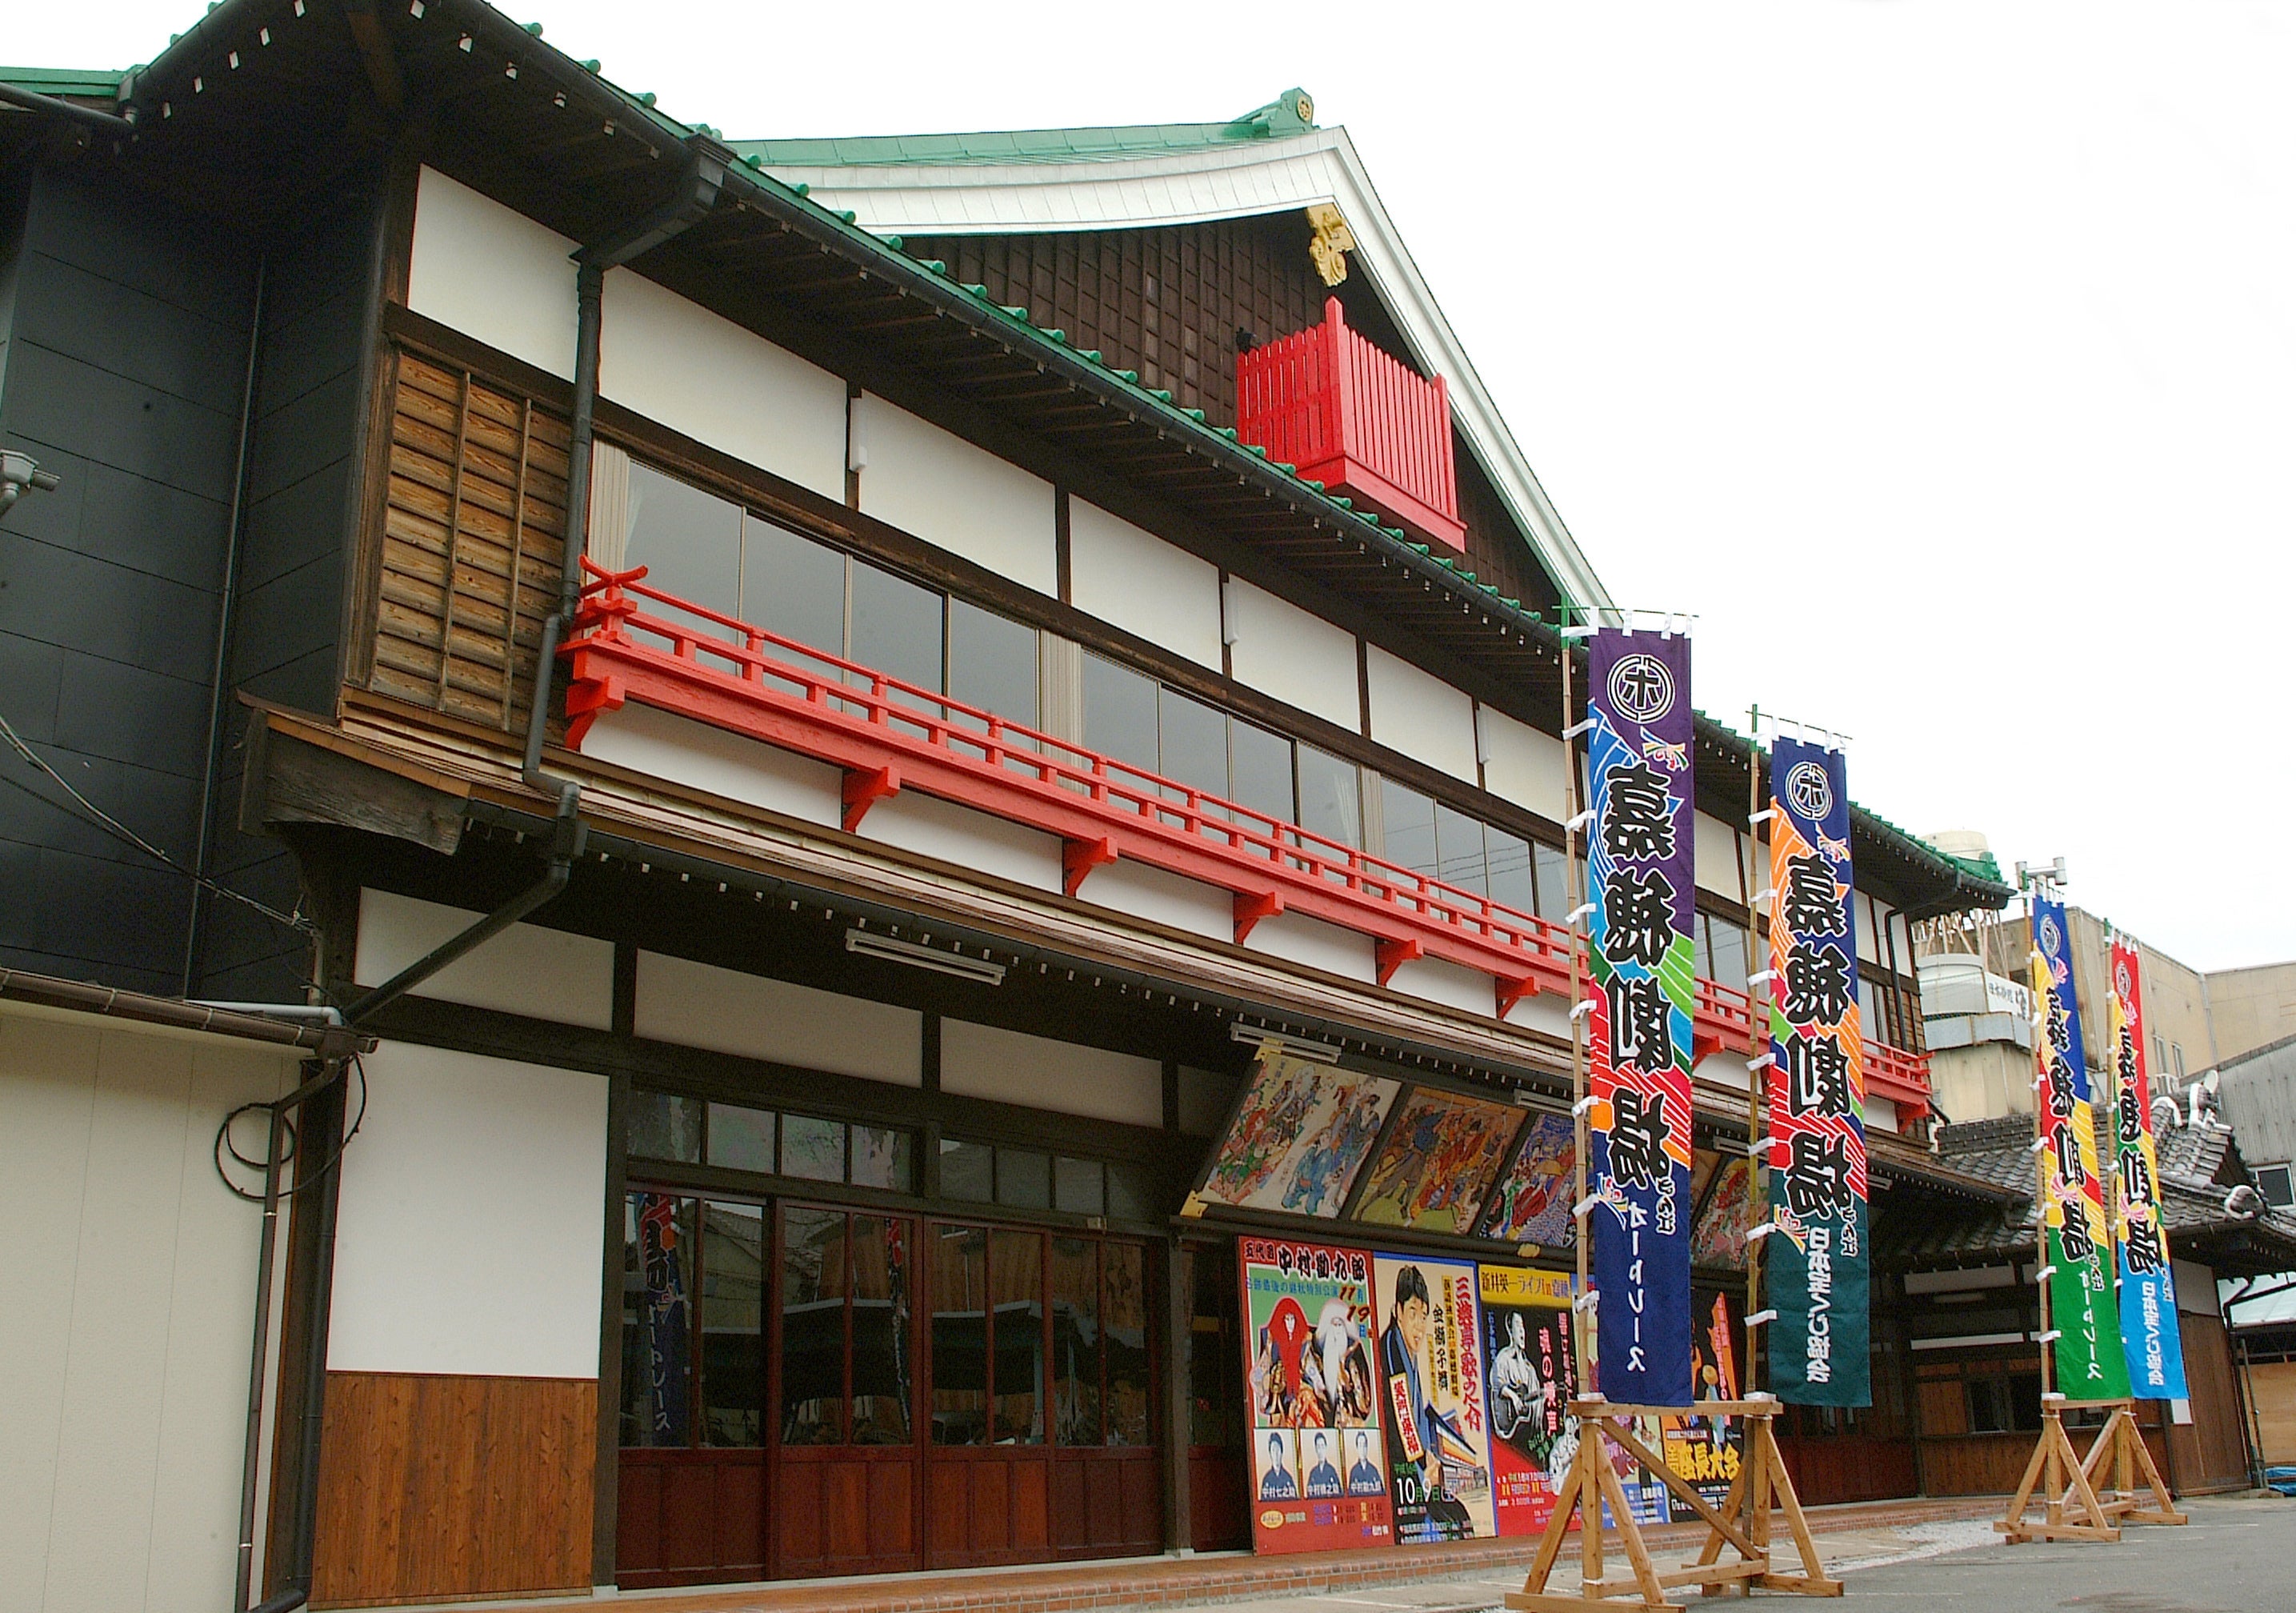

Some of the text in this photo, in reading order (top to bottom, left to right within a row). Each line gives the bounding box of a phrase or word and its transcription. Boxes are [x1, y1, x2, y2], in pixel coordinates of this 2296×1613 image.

[1278, 1245, 1366, 1283] 中村勘九郎
